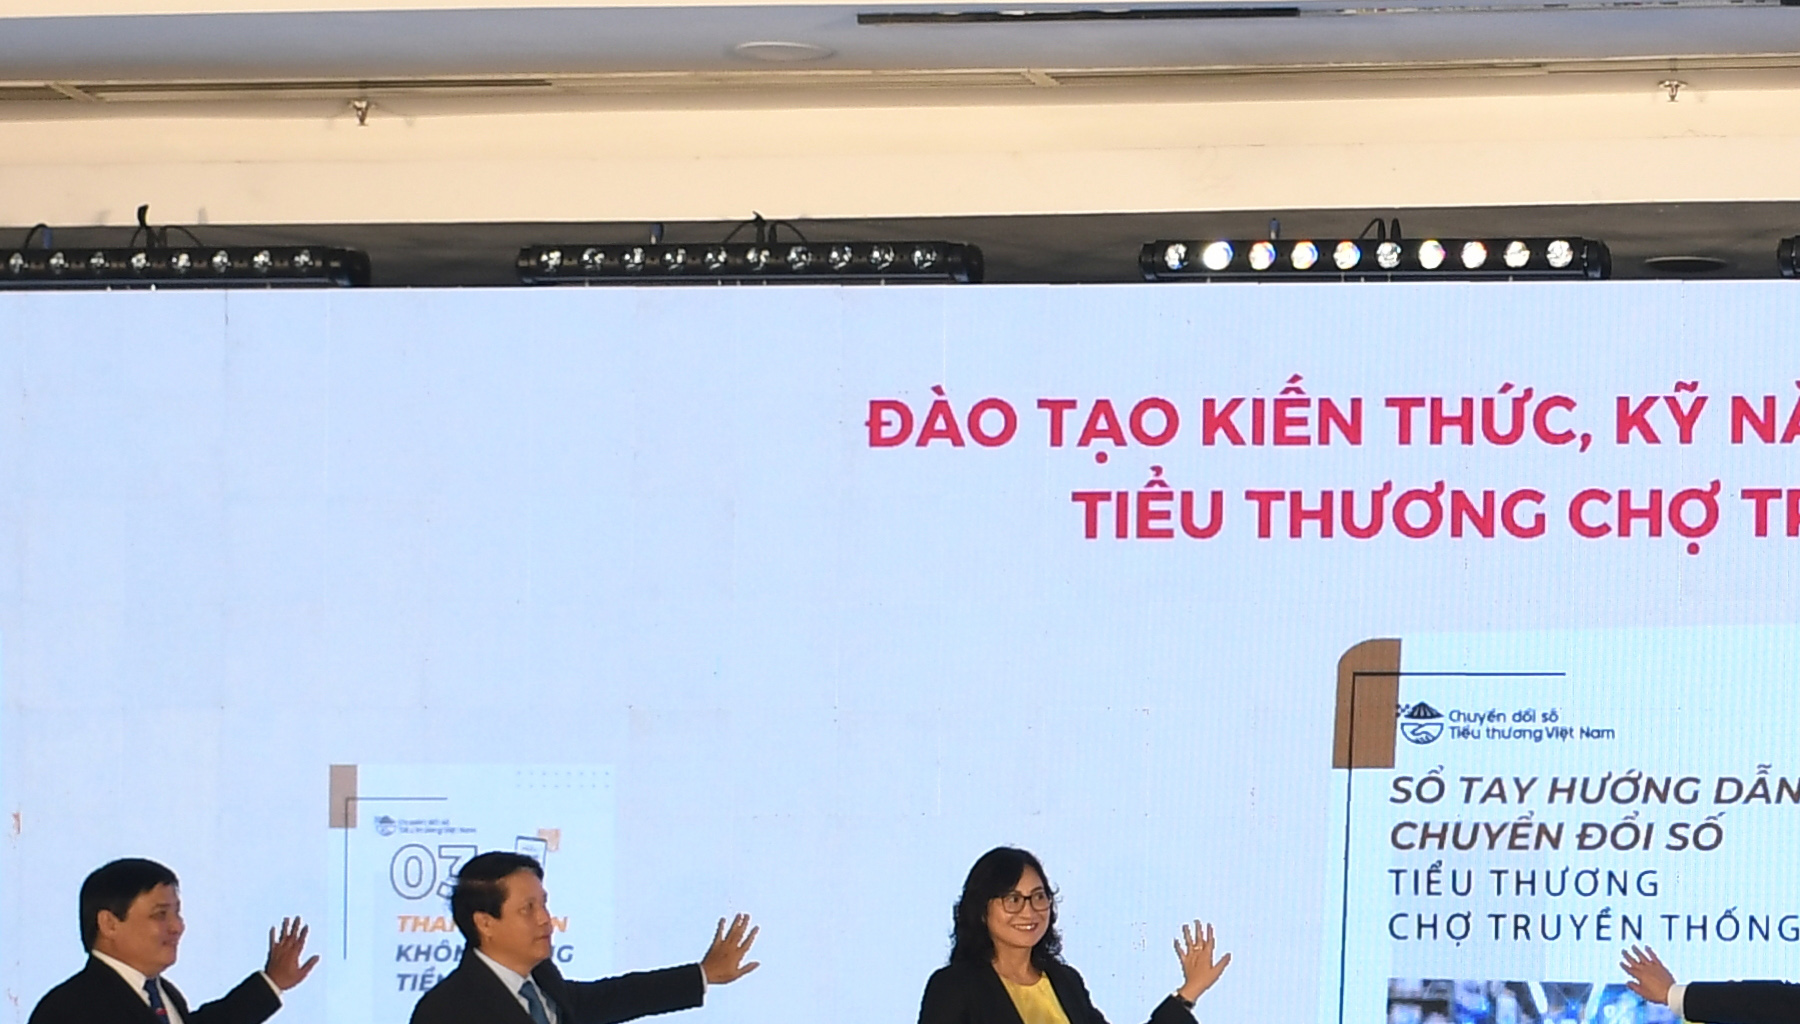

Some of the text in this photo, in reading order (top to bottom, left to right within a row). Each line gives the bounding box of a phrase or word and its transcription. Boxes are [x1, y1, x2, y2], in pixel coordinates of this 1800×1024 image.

[866, 386, 1018, 447] ĐÀO
[1038, 397, 1180, 465] TẠO
[1202, 374, 1363, 446] KIẾN
[1385, 382, 1592, 452] THỨC,
[1616, 381, 1707, 445] KỸ
[1072, 465, 1224, 540] TIỂU
[1245, 480, 1547, 539] THƯƠNG
[1567, 481, 1721, 555] CHỢ
[1485, 727, 1543, 743] thương
[1545, 726, 1574, 742] Việt
[1579, 727, 1616, 740] Nam
[1388, 764, 1446, 804] SỔ
[1459, 776, 1539, 804] TAY
[1547, 768, 1702, 805] HƯỚNG
[1390, 810, 1727, 852] CHUYỂN ĐỔI SỐ
[1388, 859, 1658, 897] TIỂU THƯƠNG
[1388, 910, 1472, 947] CHỢ
[1660, 906, 1800, 942] THỐNG
